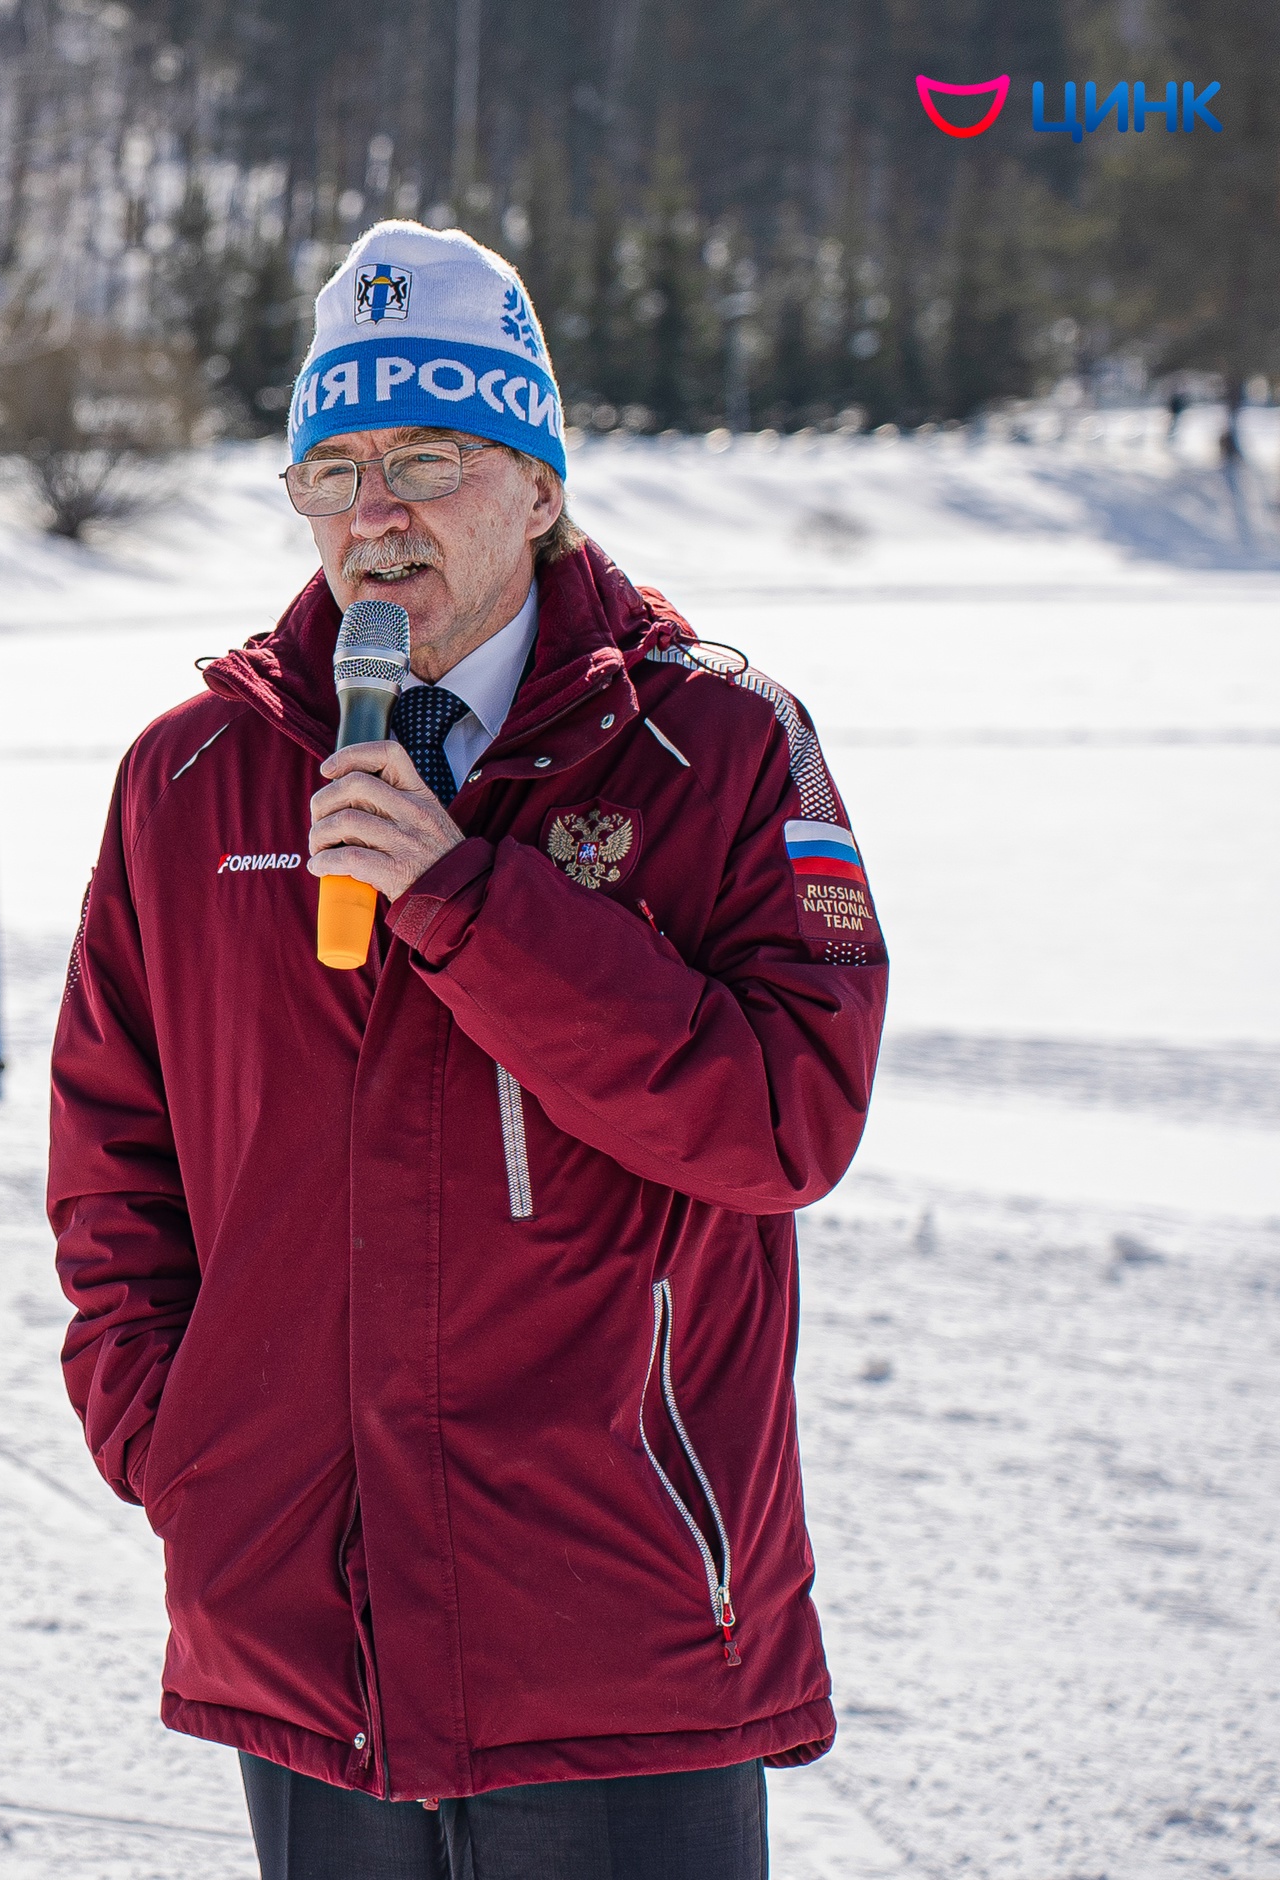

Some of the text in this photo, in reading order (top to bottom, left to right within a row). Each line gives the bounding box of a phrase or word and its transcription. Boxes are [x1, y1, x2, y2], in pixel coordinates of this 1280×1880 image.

[289, 360, 359, 444] НЯ
[217, 853, 301, 874] FORWARD
[807, 884, 865, 904] RUSSIAN
[802, 898, 873, 919] NATIONAL
[823, 913, 864, 931] TEAM
